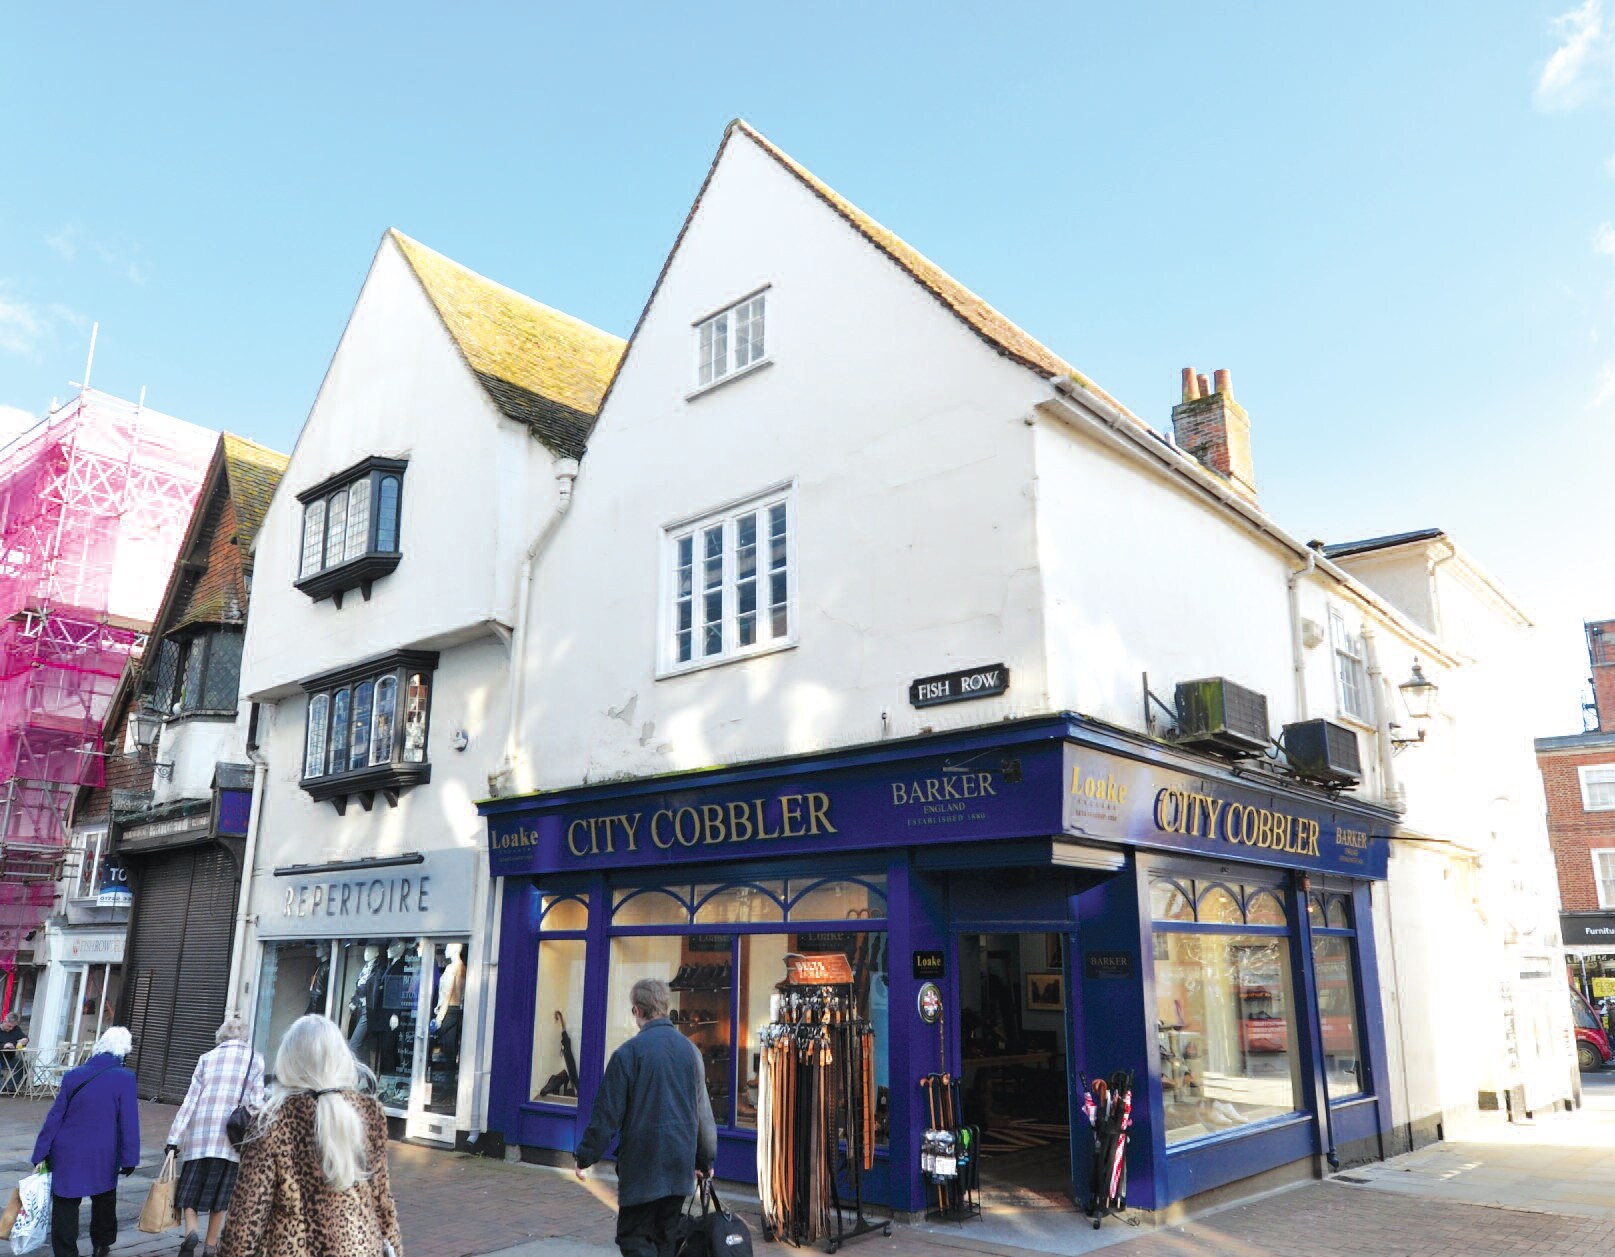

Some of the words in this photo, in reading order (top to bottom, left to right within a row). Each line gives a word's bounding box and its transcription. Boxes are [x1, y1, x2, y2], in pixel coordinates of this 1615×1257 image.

[918, 680, 950, 700] FISH
[960, 671, 999, 692] ROW
[891, 773, 997, 805] BARKER
[1071, 766, 1128, 804] Loake
[907, 814, 964, 827] ESTABLISHED
[923, 802, 966, 814] ENGLAND
[567, 813, 642, 856] CITY
[651, 792, 839, 849] COBBLER
[1160, 788, 1223, 839] CITY
[1226, 803, 1320, 857] COBBLER
[491, 827, 539, 850] Loake
[1336, 827, 1368, 848] BARKER
[284, 876, 431, 918] REPERTOIRE
[917, 955, 941, 966] Loake
[1090, 956, 1127, 966] BARKER
